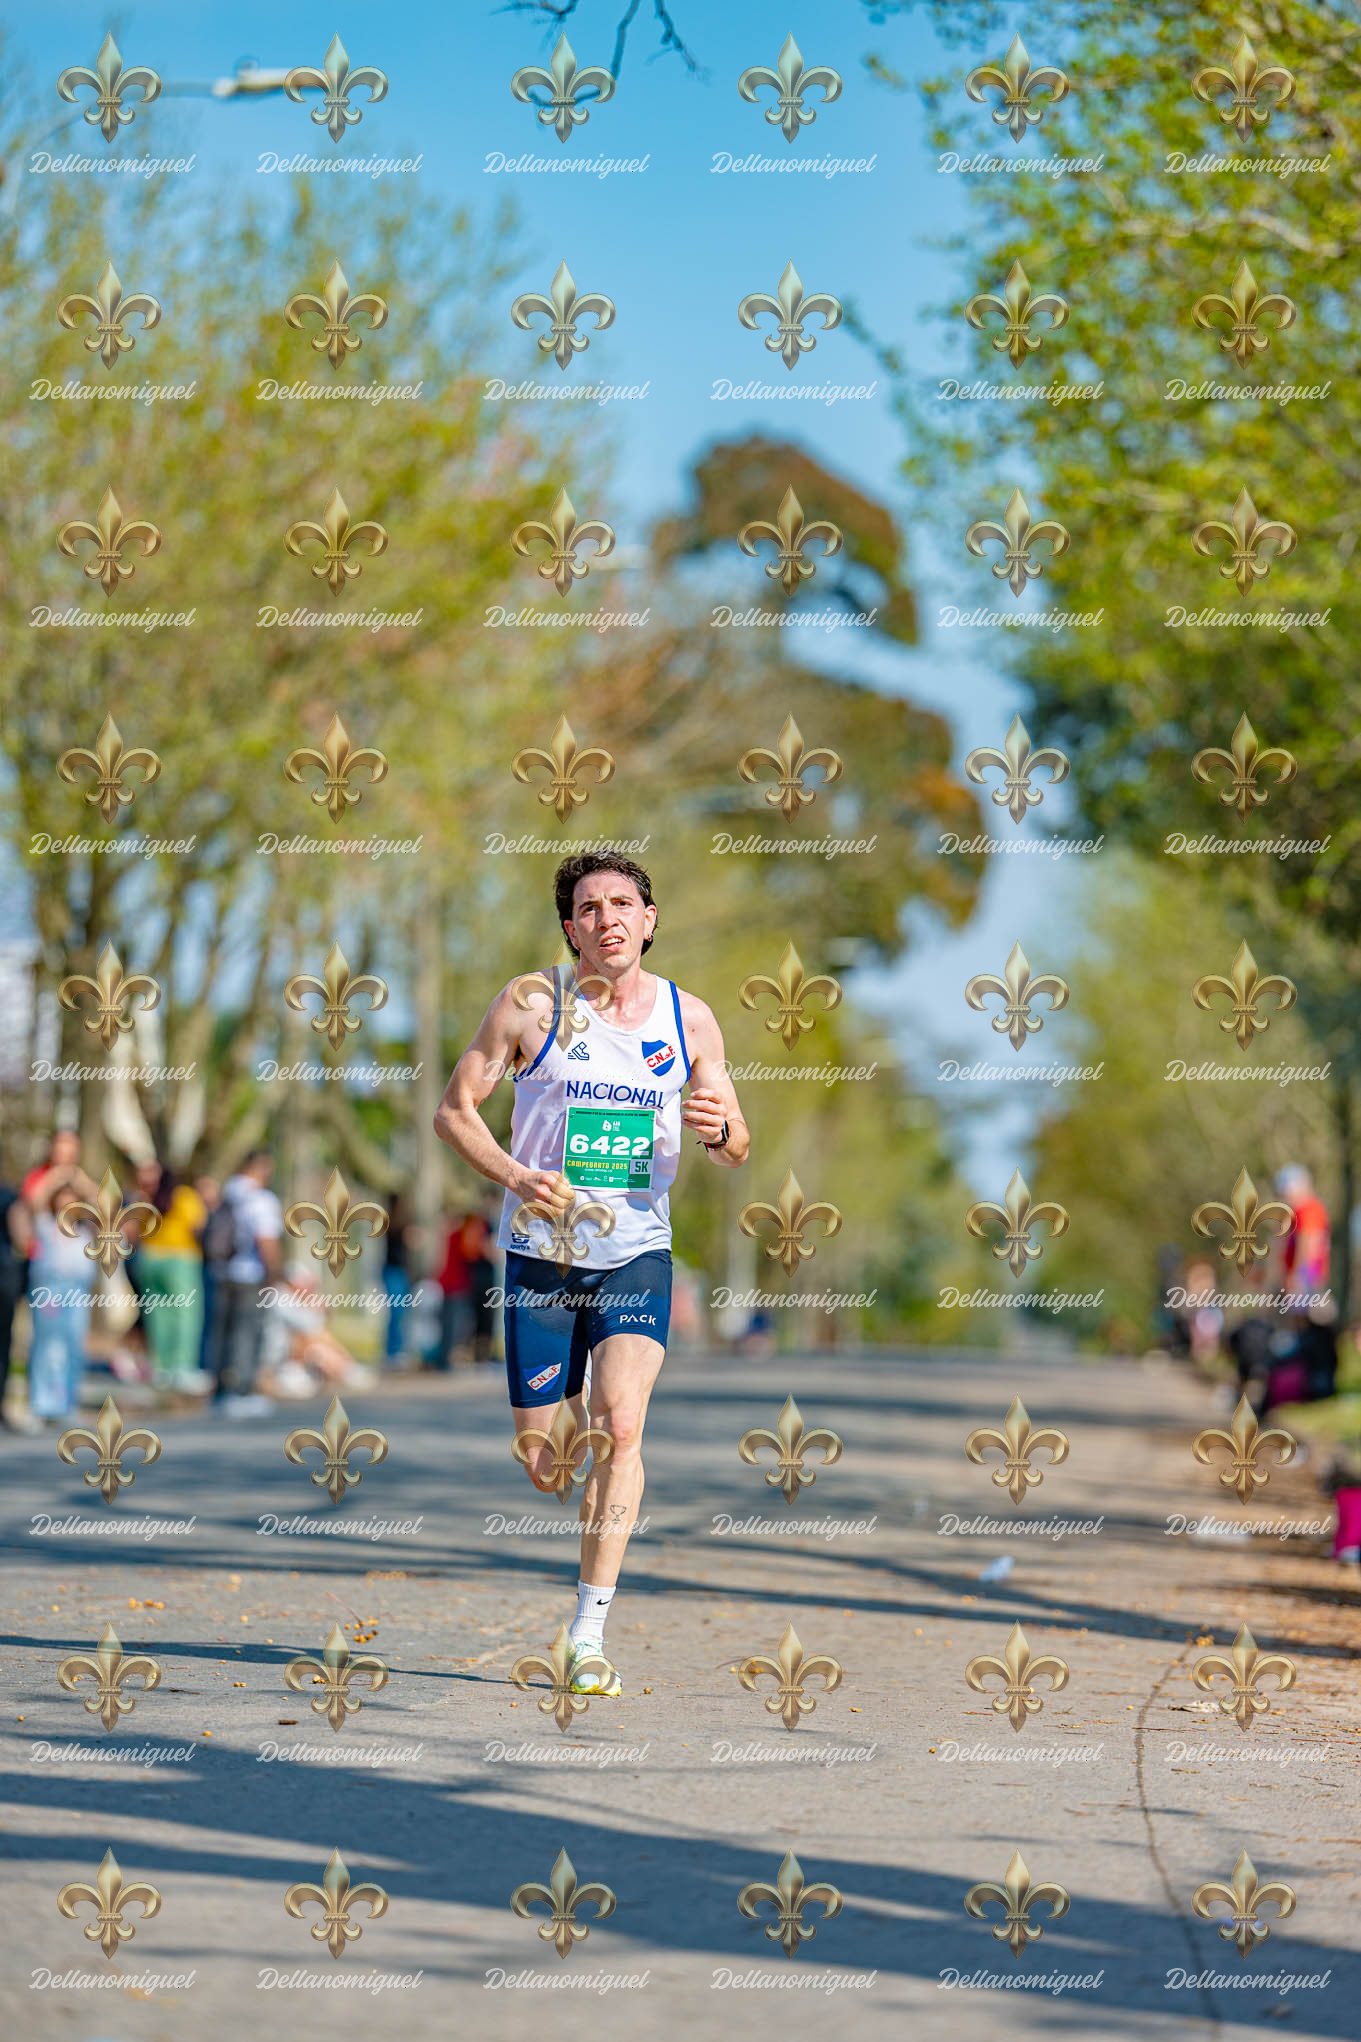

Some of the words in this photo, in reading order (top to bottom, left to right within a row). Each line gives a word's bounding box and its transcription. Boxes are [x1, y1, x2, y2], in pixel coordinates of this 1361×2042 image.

[566, 1080, 665, 1109] NACIONAL
[569, 1133, 650, 1157] 6422
[566, 1159, 610, 1169] CAMPEONATO
[634, 1161, 649, 1173] 5K
[619, 1315, 657, 1327] PACK
